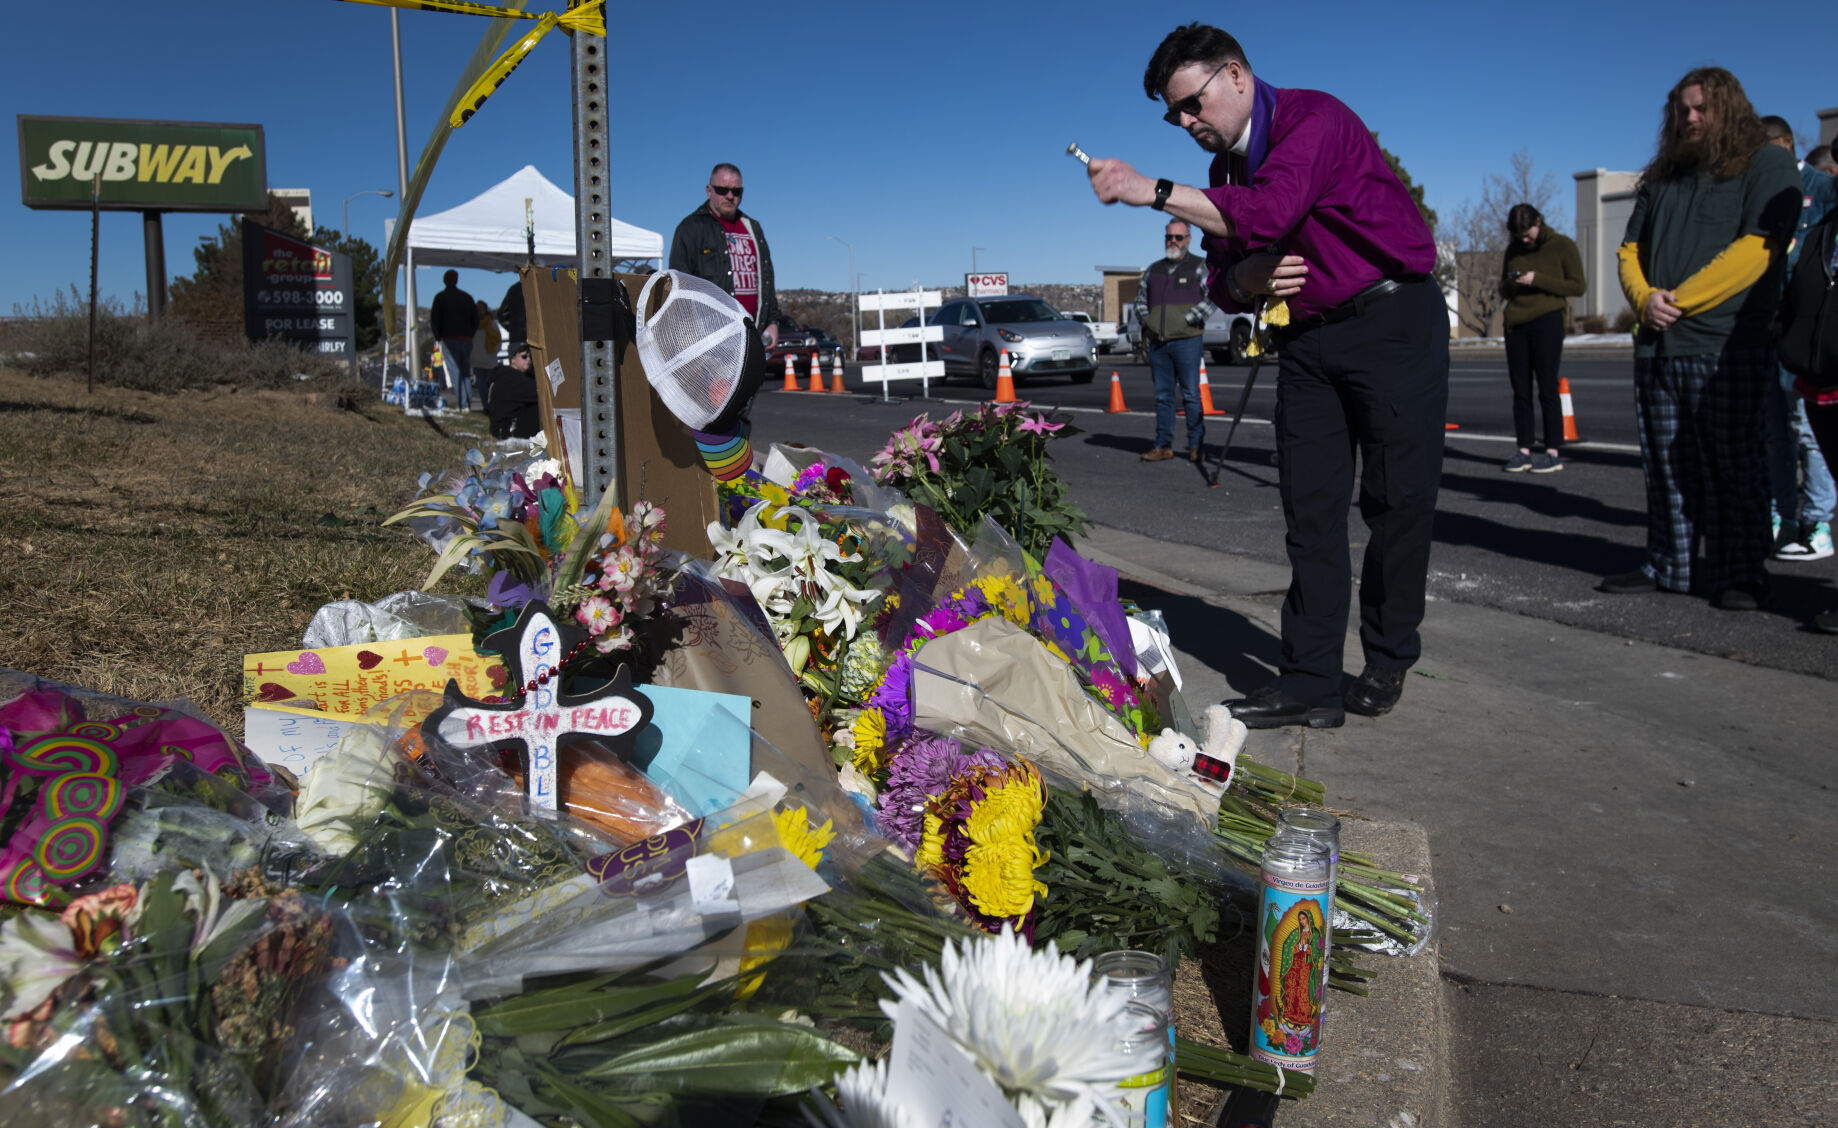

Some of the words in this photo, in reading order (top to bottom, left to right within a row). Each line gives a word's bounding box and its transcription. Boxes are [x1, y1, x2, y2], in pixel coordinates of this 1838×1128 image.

[32, 140, 253, 185] SUBWAY
[273, 248, 293, 258] the
[262, 252, 332, 274] retail
[271, 274, 313, 284] group
[981, 275, 1006, 286] CVS
[265, 318, 292, 330] FOR
[296, 318, 335, 330] LEASE
[331, 679, 350, 698] ALL
[466, 711, 530, 740] REST
[534, 712, 561, 731] IN
[571, 707, 632, 731] PEACE
[1272, 876, 1293, 888] Virgen
